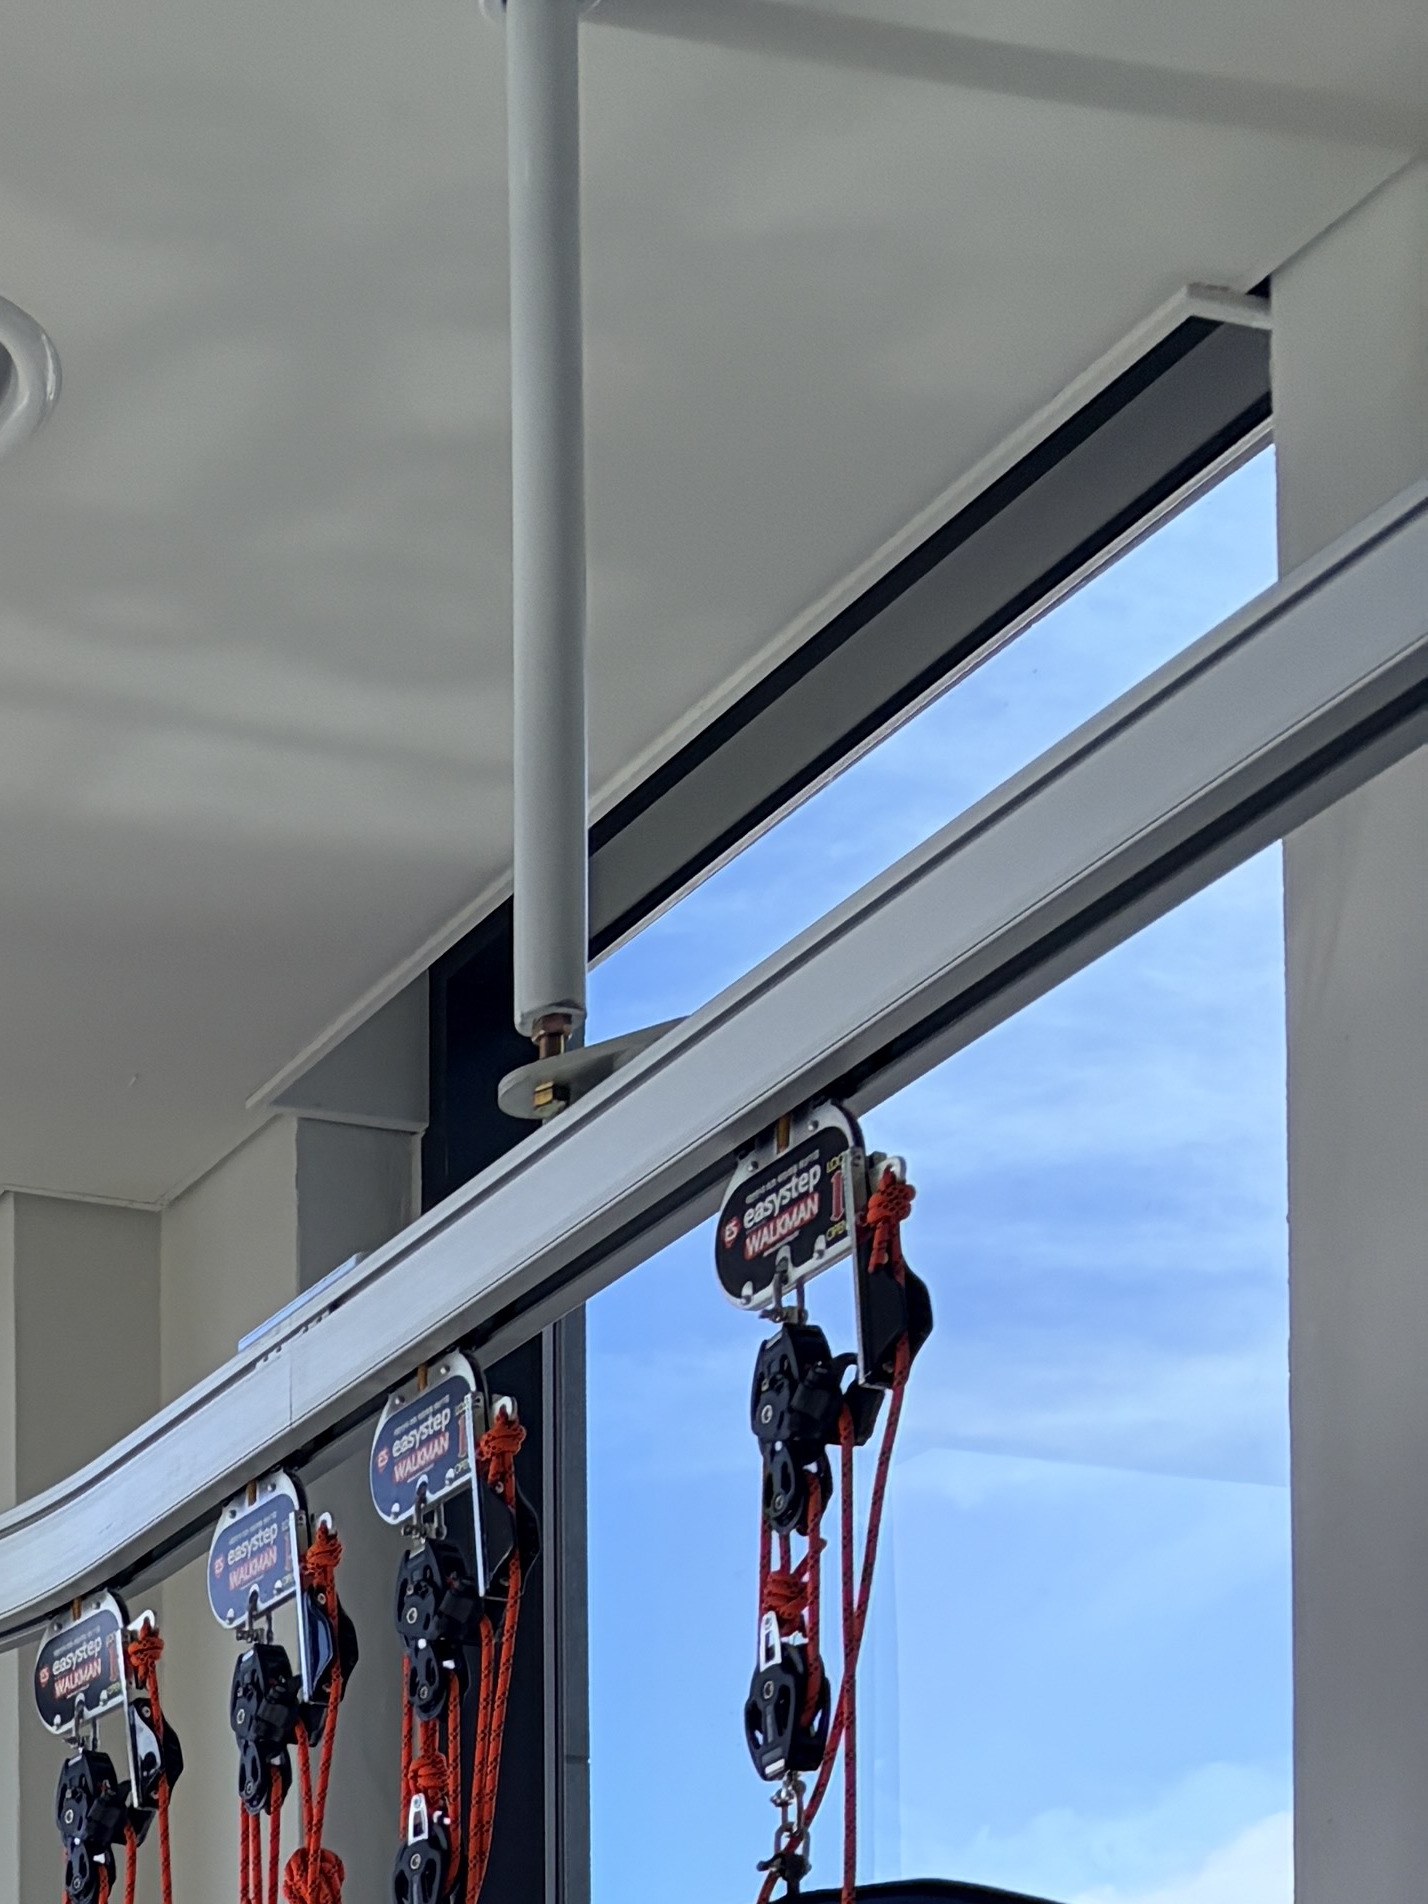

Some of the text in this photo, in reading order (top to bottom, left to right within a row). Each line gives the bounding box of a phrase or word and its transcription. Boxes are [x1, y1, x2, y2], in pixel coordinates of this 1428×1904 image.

[744, 1165, 821, 1229] easystep
[745, 1193, 820, 1257] WALKMAN
[393, 1408, 451, 1457] easystep
[394, 1432, 450, 1482] WALKMAN
[228, 1523, 278, 1565] easystep
[53, 1637, 102, 1675] easystep
